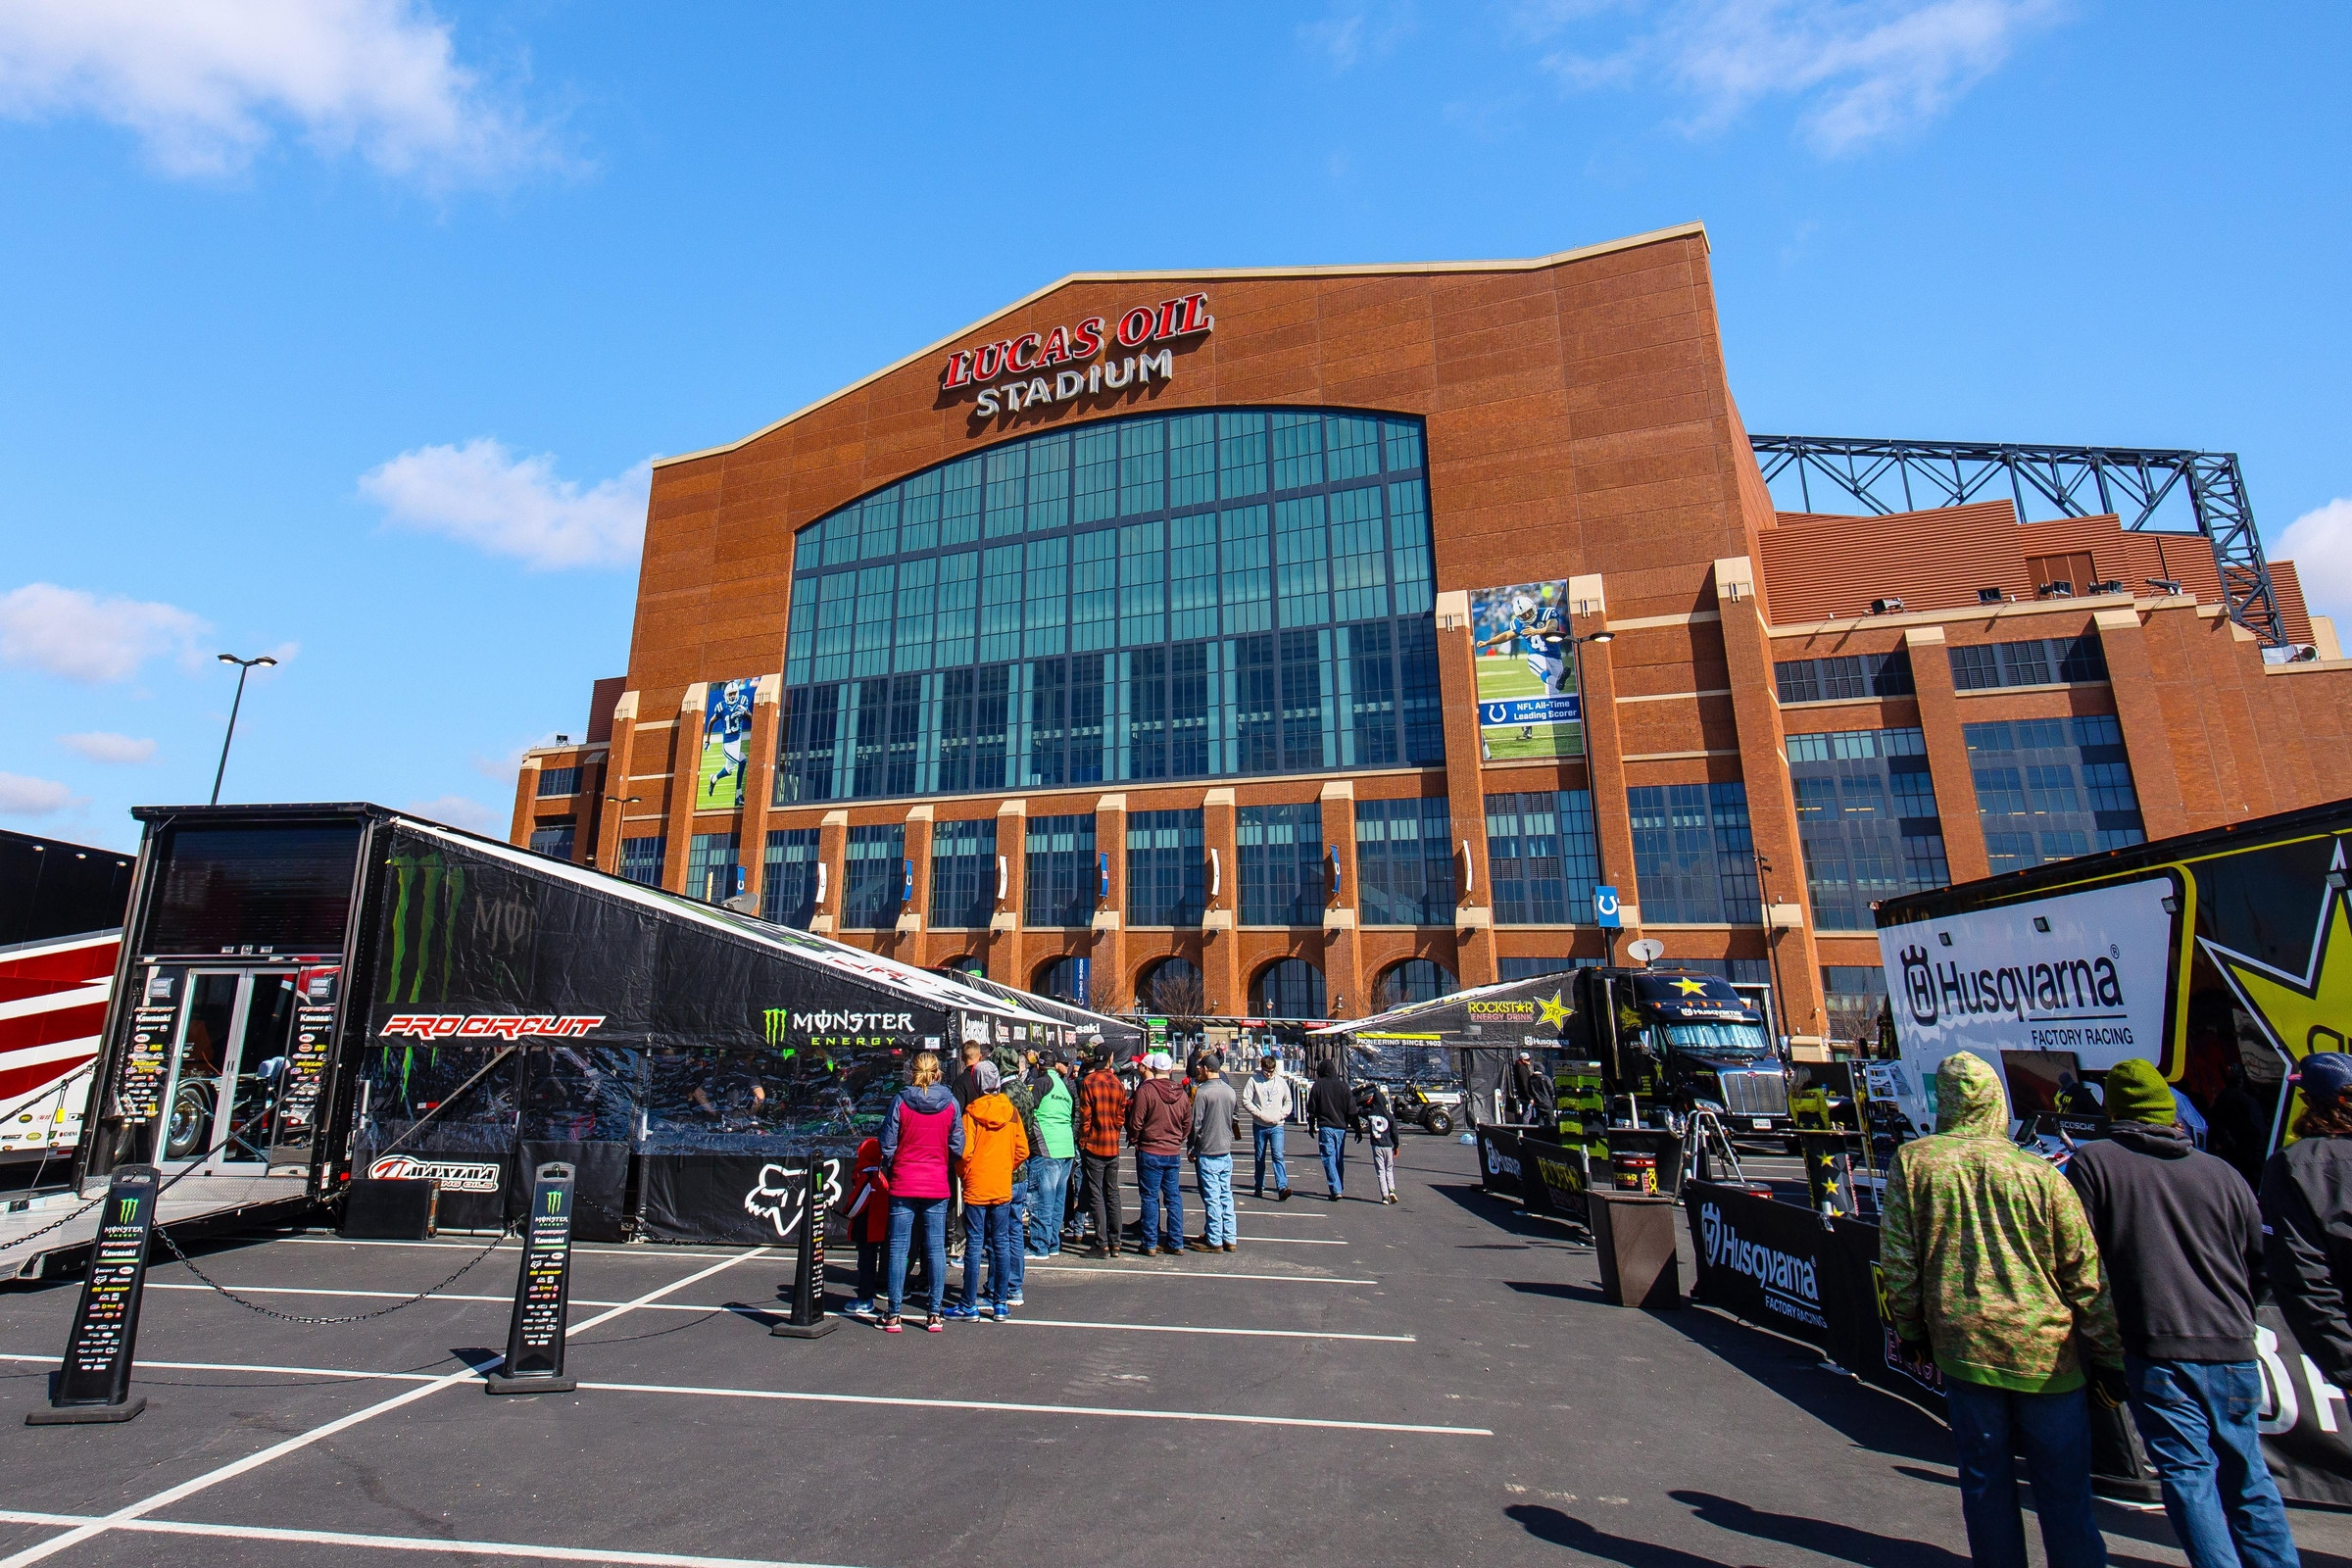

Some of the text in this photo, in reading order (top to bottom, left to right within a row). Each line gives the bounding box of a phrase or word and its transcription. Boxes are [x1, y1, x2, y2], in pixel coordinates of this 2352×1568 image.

[943, 292, 1215, 391] LUCAS OIL
[977, 349, 1173, 417] STADIUM
[1514, 709, 1578, 721] Leading Scorer
[1517, 700, 1570, 711] NFL All-Time
[1936, 956, 2125, 1022] Husqvarna
[135, 1013, 172, 1022] Kawasaki
[300, 1013, 333, 1022] Kawasak
[1469, 1002, 1535, 1014] ROCKSTAR
[379, 1015, 606, 1040] PRO CIRCUIT
[793, 1008, 915, 1034] MONSTER
[810, 1037, 896, 1046] ENERGY
[2031, 1027, 2134, 1047] FACTORY RACING
[104, 1225, 143, 1234] MONSTER
[1720, 1223, 1819, 1300] Husqvarna
[1765, 1295, 1829, 1329] FACTORY RACING
